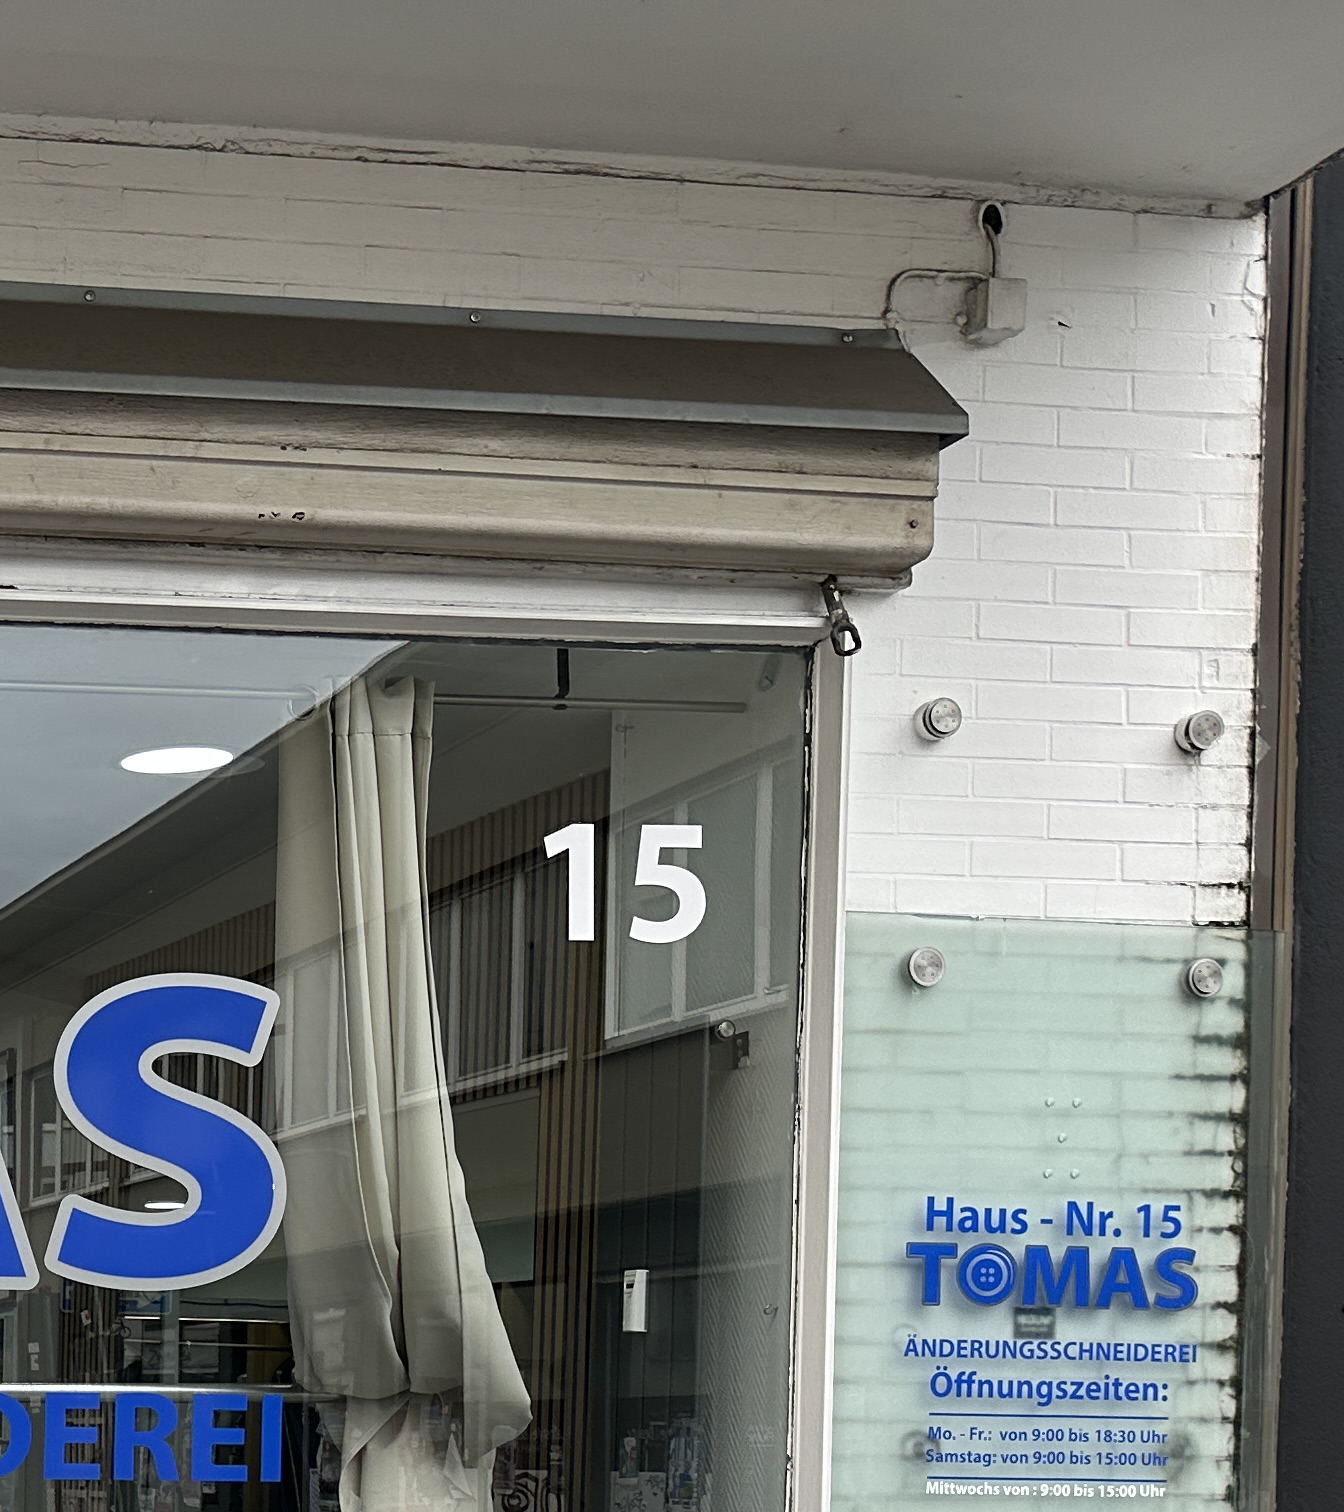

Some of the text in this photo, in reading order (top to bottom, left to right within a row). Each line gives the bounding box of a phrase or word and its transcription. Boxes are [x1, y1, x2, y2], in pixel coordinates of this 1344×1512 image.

[543, 823, 708, 945] 15
[925, 1196, 1028, 1235] Haus
[1066, 1200, 1122, 1238] Nr.
[1136, 1204, 1183, 1239] 15
[906, 1242, 1199, 1311] TOMAS
[903, 1334, 1197, 1363] ÄNDERUNGSSCHNEIDEREI
[929, 1366, 1169, 1407] Öffnungszeiten:
[927, 1426, 956, 1441] Mo.
[999, 1430, 1027, 1442] von
[1032, 1428, 1064, 1442] 9:00
[1068, 1428, 1090, 1443] bis
[1095, 1429, 1136, 1443] 18:30
[1140, 1429, 1168, 1444] Uhr
[925, 1449, 1169, 1467] Samstag: von 9:00 bis 15:00 Uhr
[925, 1481, 1000, 1496] Mittwochs
[1003, 1485, 1027, 1497] von
[1040, 1484, 1071, 1497] 9:00
[1073, 1482, 1095, 1498] bis
[1098, 1484, 1137, 1498] 15:00
[1139, 1484, 1166, 1498] Uhr
